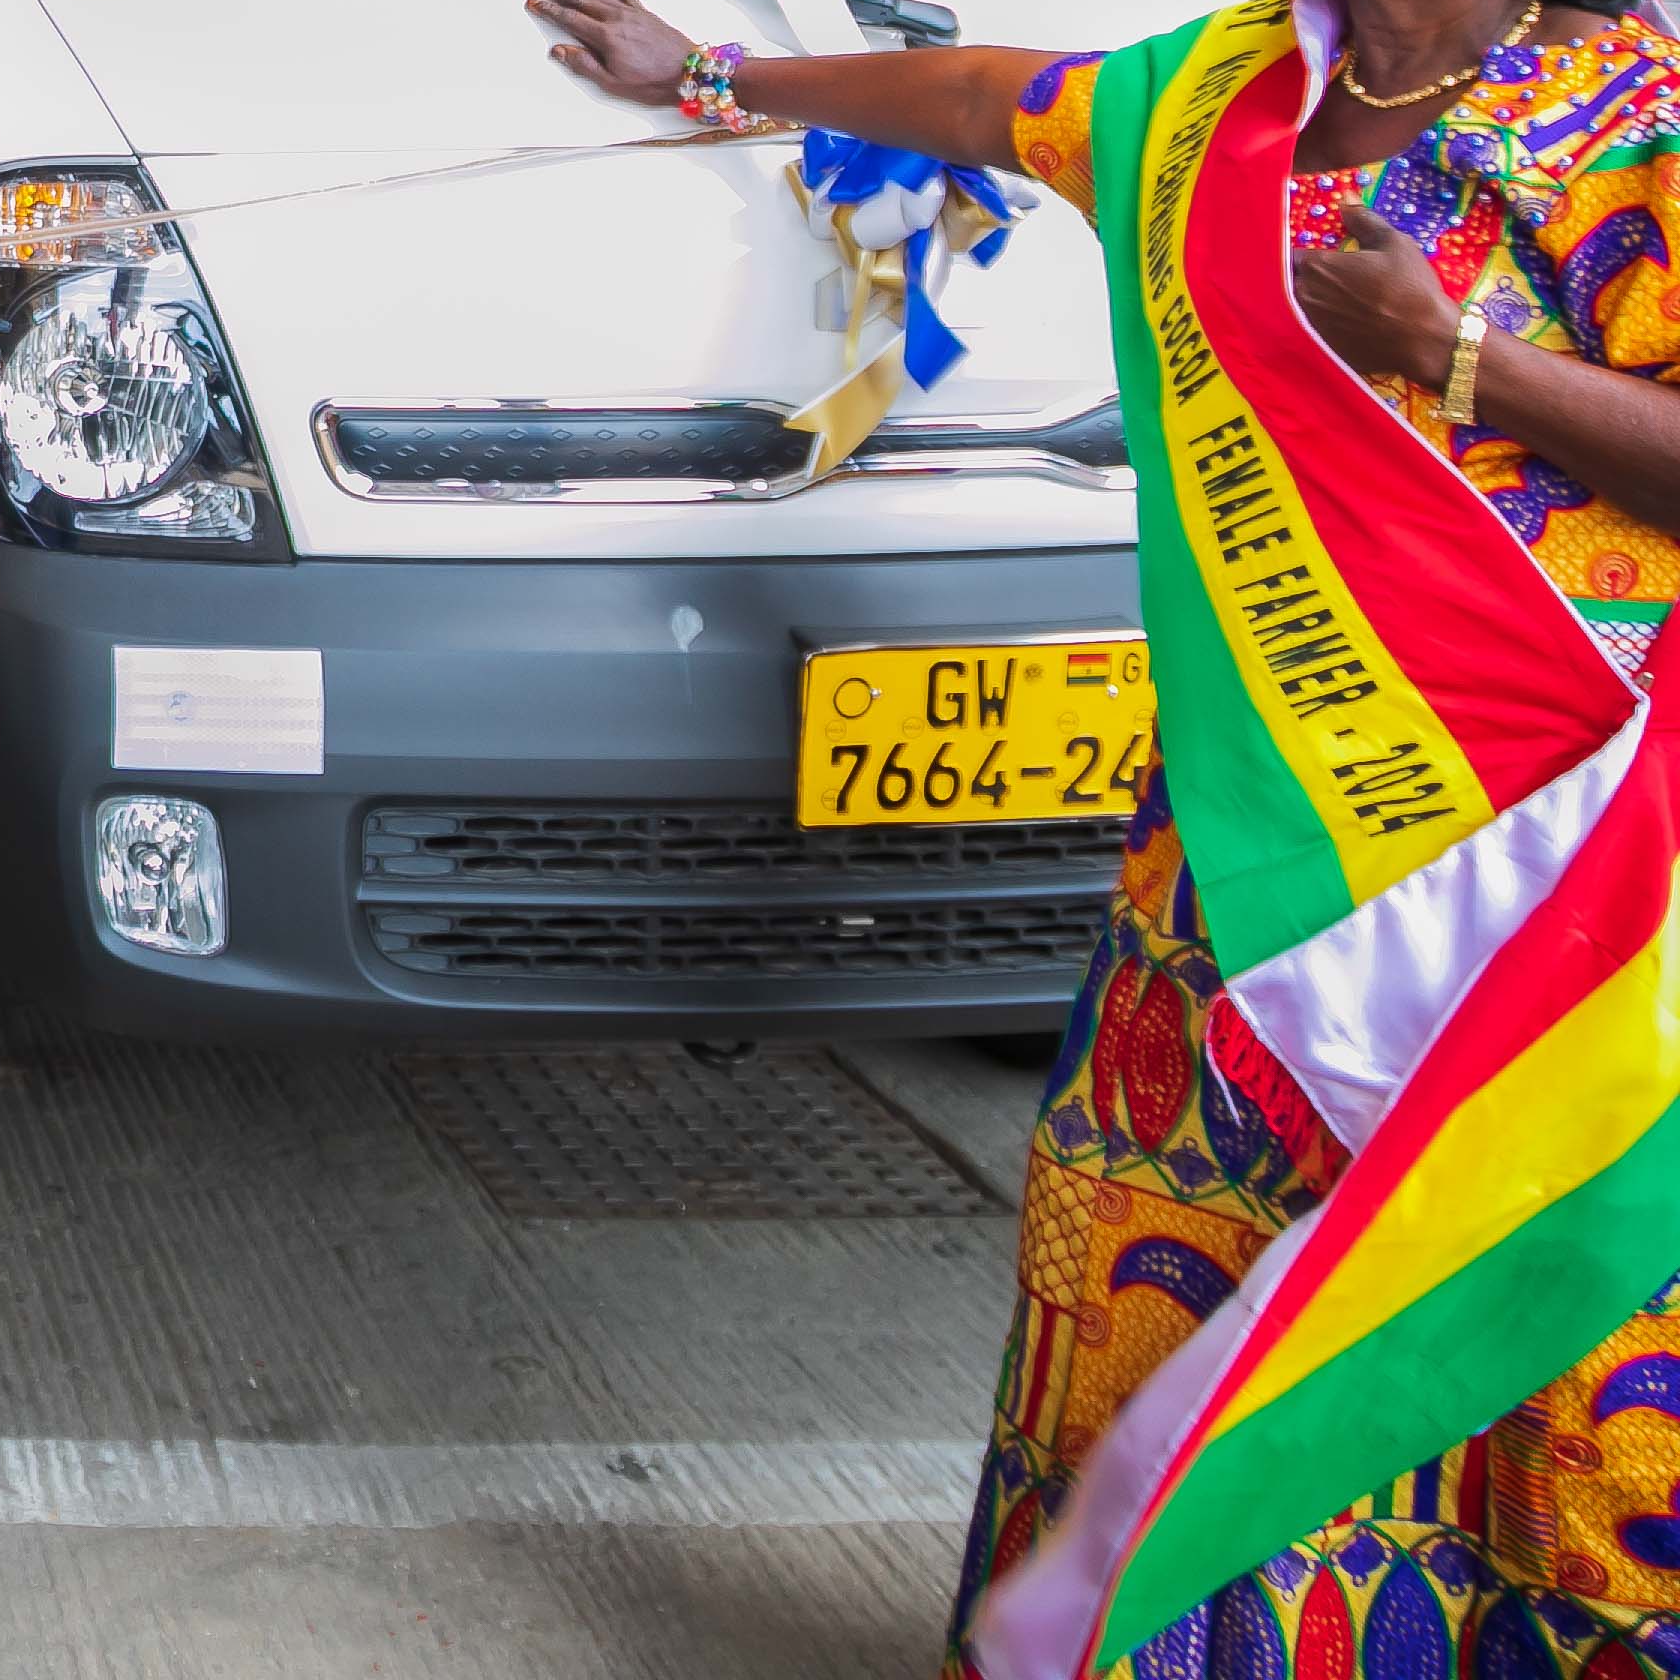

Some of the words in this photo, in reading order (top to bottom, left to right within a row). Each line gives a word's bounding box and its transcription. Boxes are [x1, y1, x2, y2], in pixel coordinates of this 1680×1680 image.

[1159, 293, 1221, 409] COCOA
[1188, 414, 1293, 564] FEMALE
[927, 657, 1017, 729] GW
[1234, 565, 1379, 720] FARMER
[1332, 743, 1458, 838] 2024
